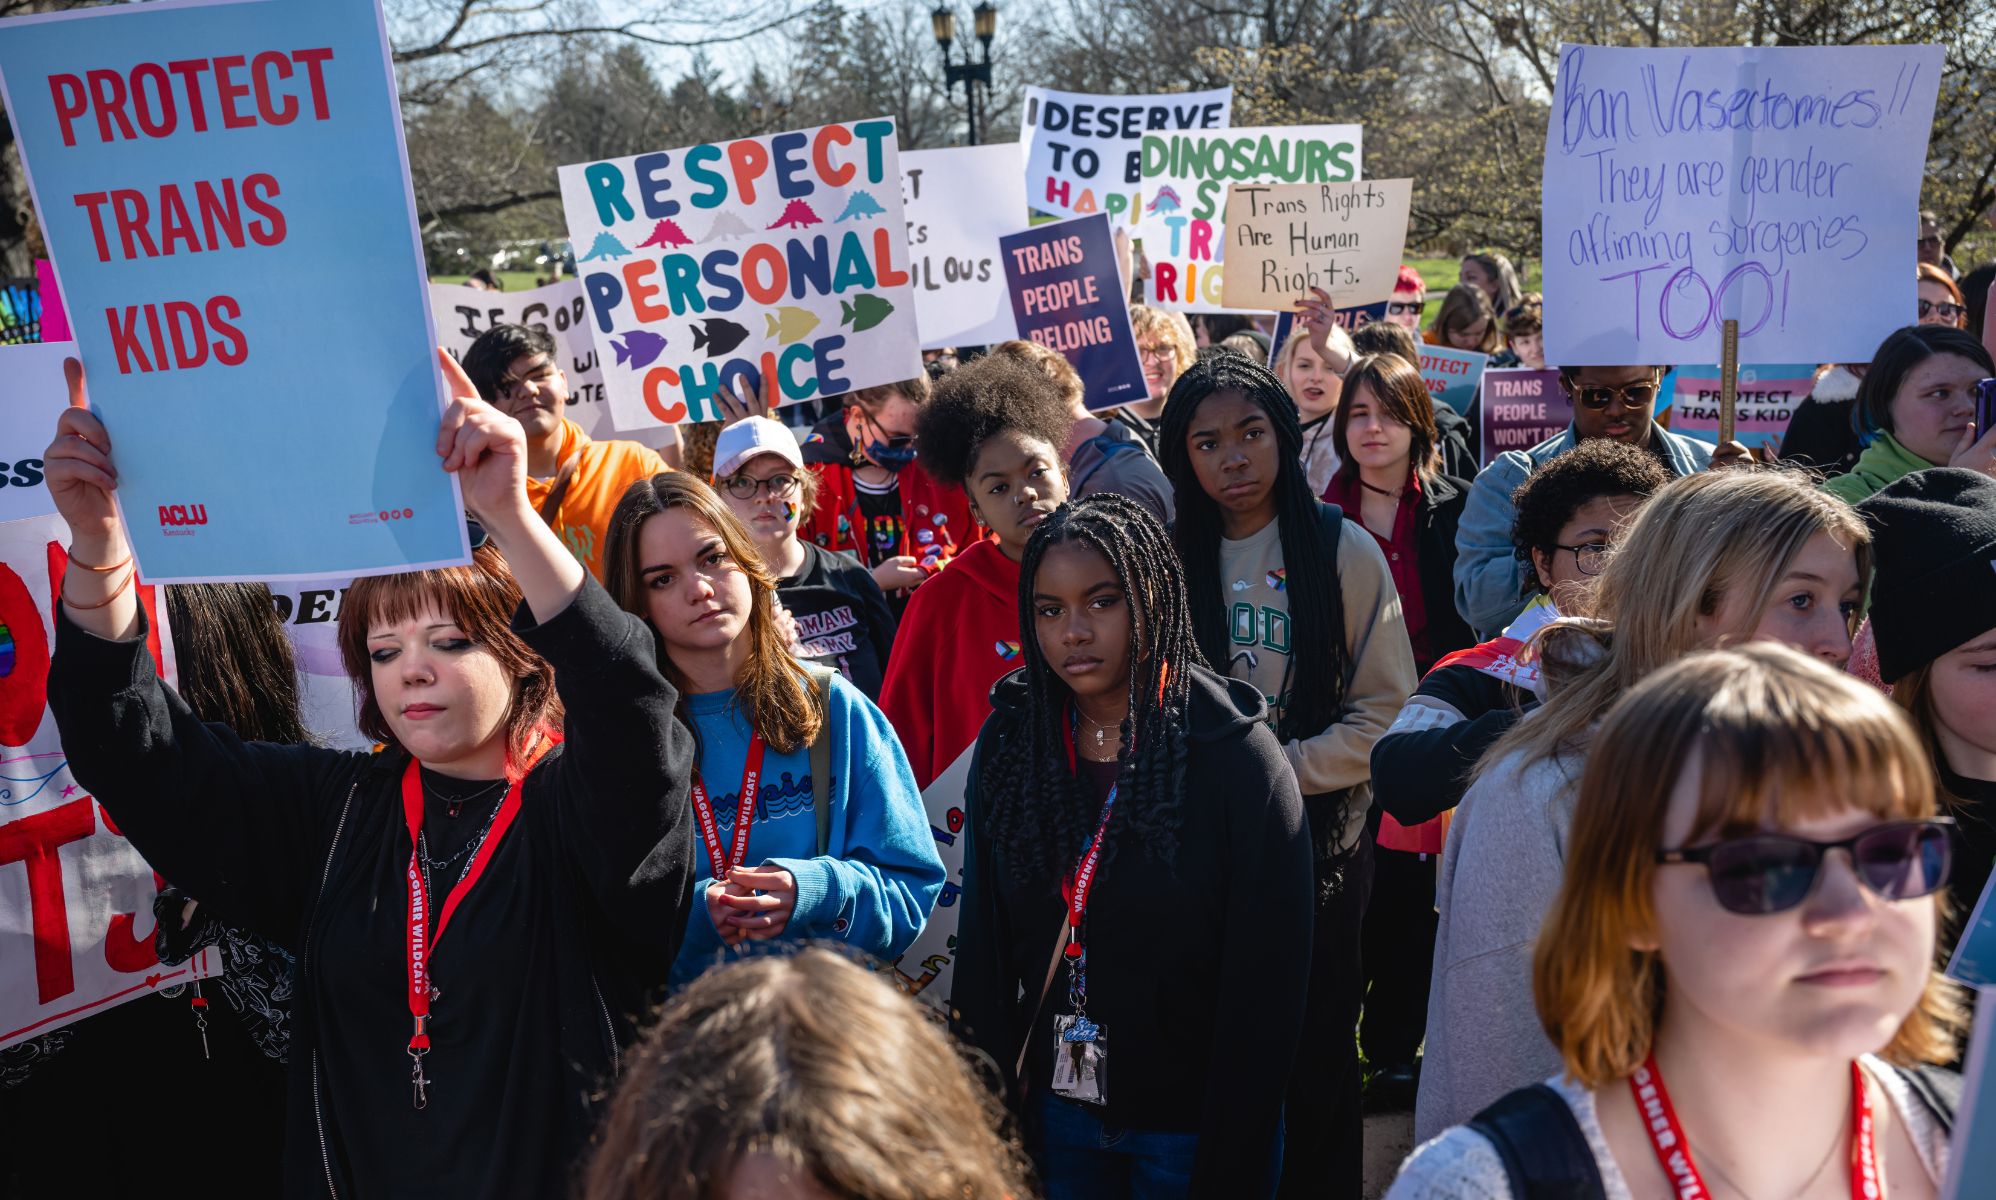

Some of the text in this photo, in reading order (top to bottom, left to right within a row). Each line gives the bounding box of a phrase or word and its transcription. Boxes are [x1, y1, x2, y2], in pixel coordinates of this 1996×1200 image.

[48, 47, 334, 147] PROTECT
[1561, 47, 1640, 155] Ban
[1043, 101, 1224, 139] DESERVE
[584, 120, 894, 228] RESPECT
[1047, 141, 1100, 179] TO
[1142, 134, 1355, 184] DINOSAURS
[1234, 187, 1307, 217] Trans
[1321, 183, 1384, 222] Rights
[1580, 145, 1853, 228] They are gender
[73, 173, 288, 262] TRANS
[1238, 221, 1360, 256] Are Human
[1012, 236, 1084, 275] TRANS
[1709, 214, 1869, 277] surgeries
[584, 227, 910, 333] PERSONAL
[1022, 275, 1100, 316] PEOPLE
[1261, 258, 1360, 301] Rights.
[1599, 260, 1790, 342] TOO!
[105, 294, 249, 375] KIDS
[1030, 316, 1113, 351] BELONG
[643, 334, 852, 424] CHOICE
[1420, 355, 1472, 376] OTECT
[1494, 379, 1543, 398] TRANS
[1493, 403, 1547, 422] PEOPLE
[1680, 406, 1795, 422] TRAS KID
[1493, 428, 1541, 446] WON'T
[158, 504, 208, 526] ACLU
[692, 785, 725, 880] WAGGENER WILDC
[733, 771, 757, 865] GENER WILDCATS
